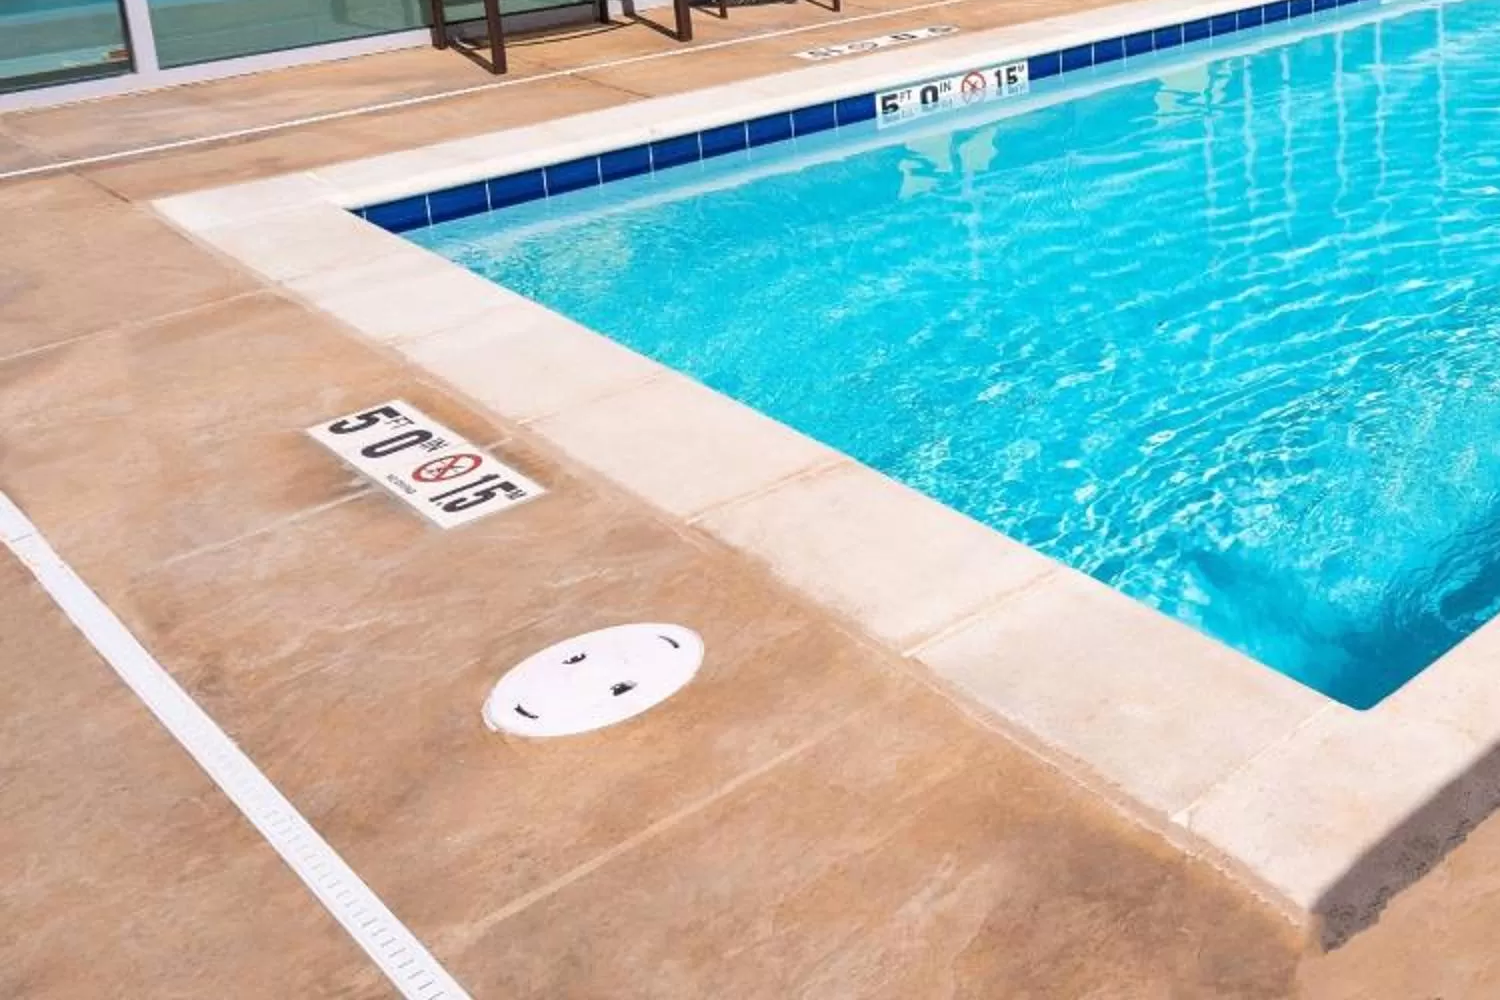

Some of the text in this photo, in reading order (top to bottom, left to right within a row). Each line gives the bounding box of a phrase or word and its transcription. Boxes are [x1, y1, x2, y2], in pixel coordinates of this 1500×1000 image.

[880, 93, 899, 115] 5
[920, 85, 939, 105] 0
[328, 406, 401, 435] 5
[361, 429, 433, 459] 0
